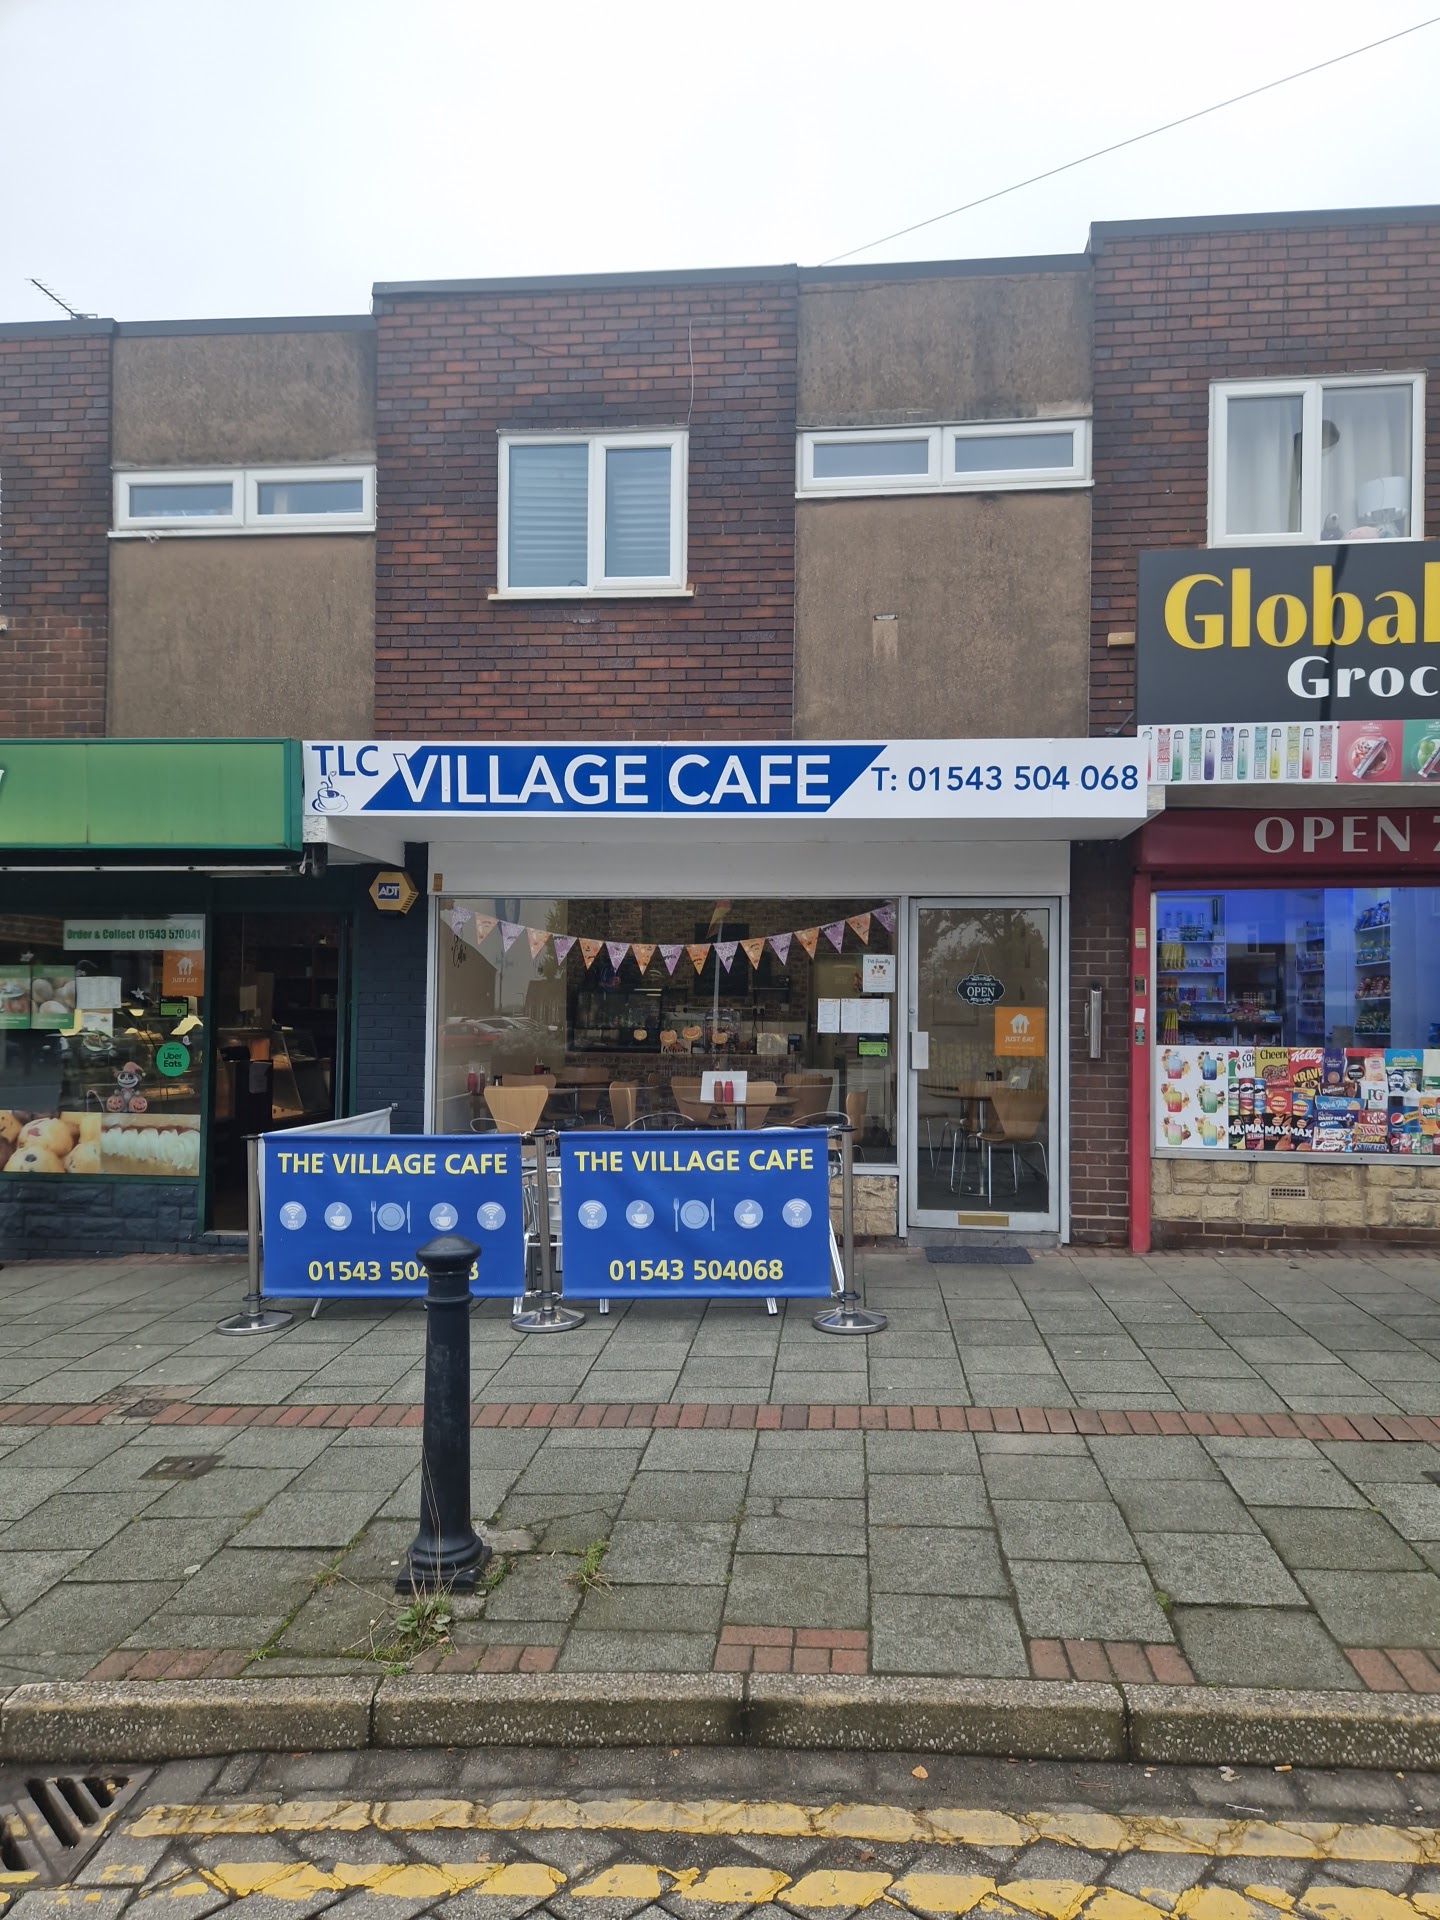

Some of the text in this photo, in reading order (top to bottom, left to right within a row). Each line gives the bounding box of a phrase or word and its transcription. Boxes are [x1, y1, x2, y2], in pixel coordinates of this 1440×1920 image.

[1164, 562, 1440, 650] Global
[1287, 656, 1439, 698] Groc
[311, 745, 379, 777] TLC
[393, 752, 831, 805] VILLAGE CAFE
[871, 765, 1139, 791] T: 01543 504 068
[1254, 816, 1411, 853] OPEN
[378, 886, 400, 896] ADT
[67, 928, 201, 940] Order & Collect 01543 570041
[967, 986, 995, 997] OPEN
[163, 1052, 182, 1060] Uber
[164, 1060, 182, 1068] Eats
[1292, 1068, 1323, 1083] KRAVE
[1265, 1126, 1289, 1135] MAX
[1290, 1127, 1313, 1138] MAX
[1361, 1126, 1385, 1135] TWIX
[277, 1153, 508, 1175] THE VILLAGE CAFE
[574, 1148, 814, 1173] THE VILLAGE CAFE
[308, 1261, 479, 1281] 01543 5048
[609, 1259, 784, 1281] 01543 504068
